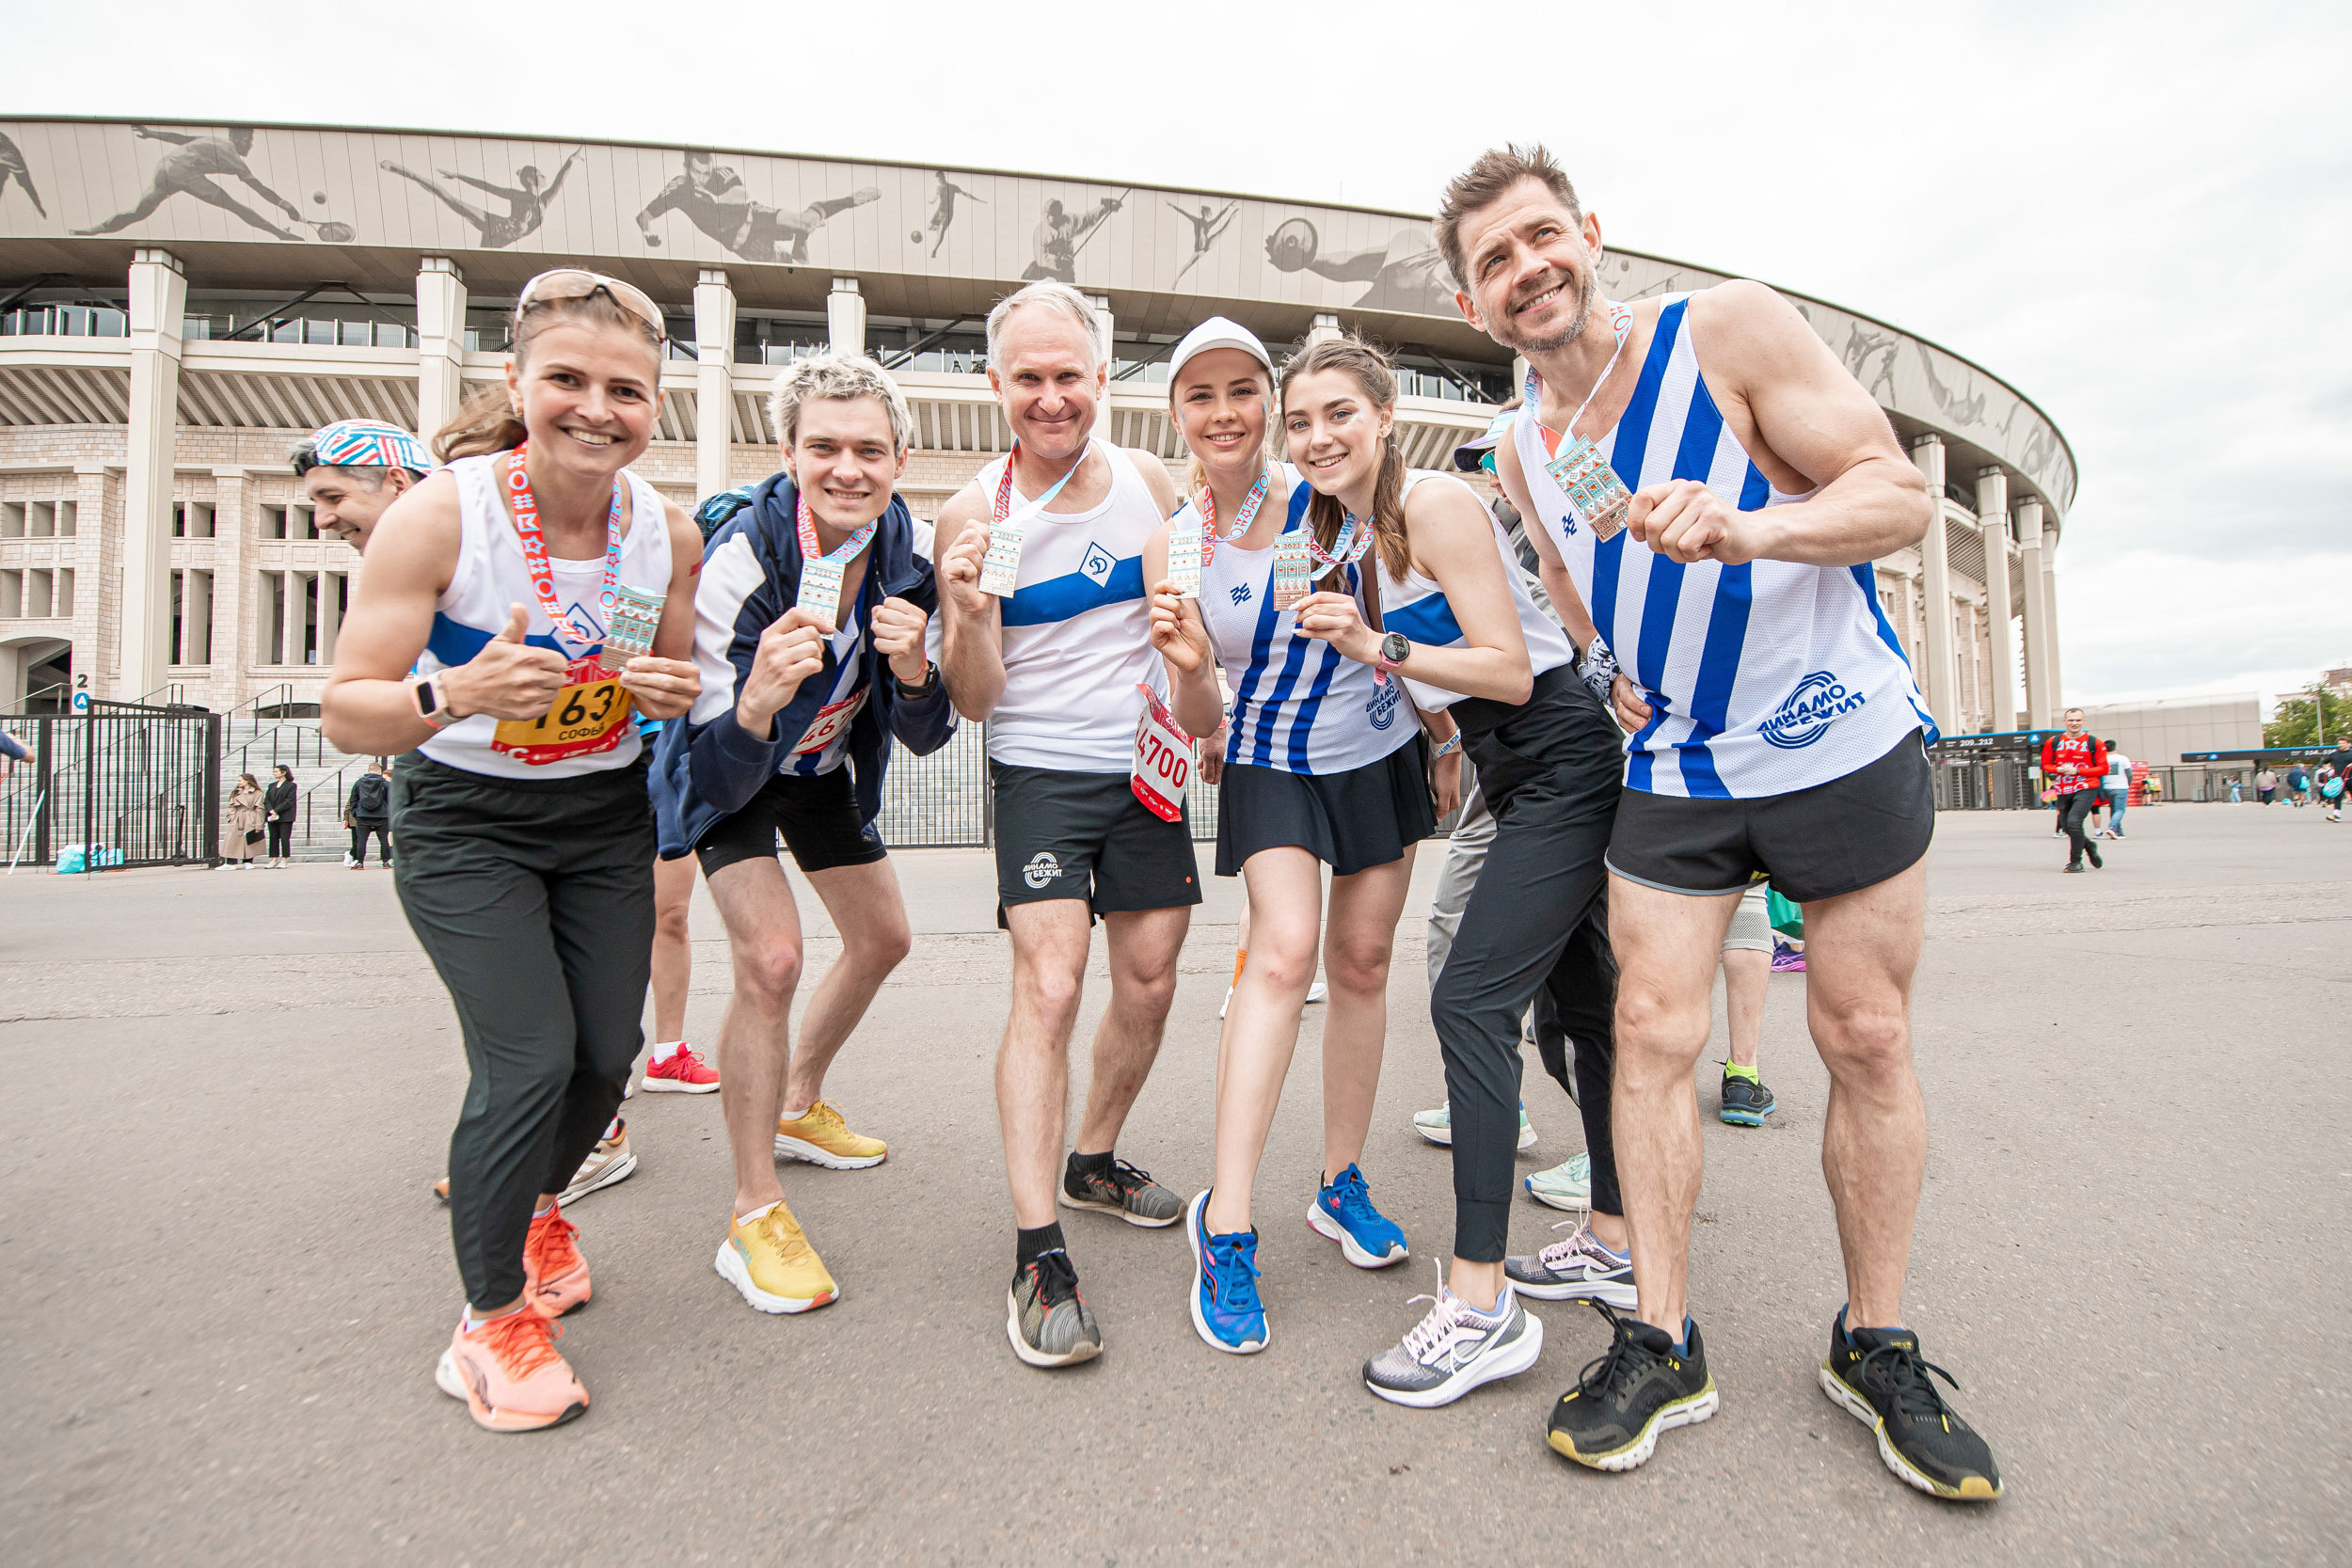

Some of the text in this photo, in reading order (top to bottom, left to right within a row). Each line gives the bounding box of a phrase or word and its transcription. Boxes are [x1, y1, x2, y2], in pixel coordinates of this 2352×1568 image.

[77, 673, 88, 688] 2
[76, 695, 87, 705] A
[1366, 685, 1394, 712] ДИНАМО
[1376, 689, 1401, 716] БЕЖИТ
[1756, 684, 1846, 732] ДИНАМО
[1023, 863, 1058, 872] ДИНАМО
[1033, 869, 1062, 878] БЕЖИТ
